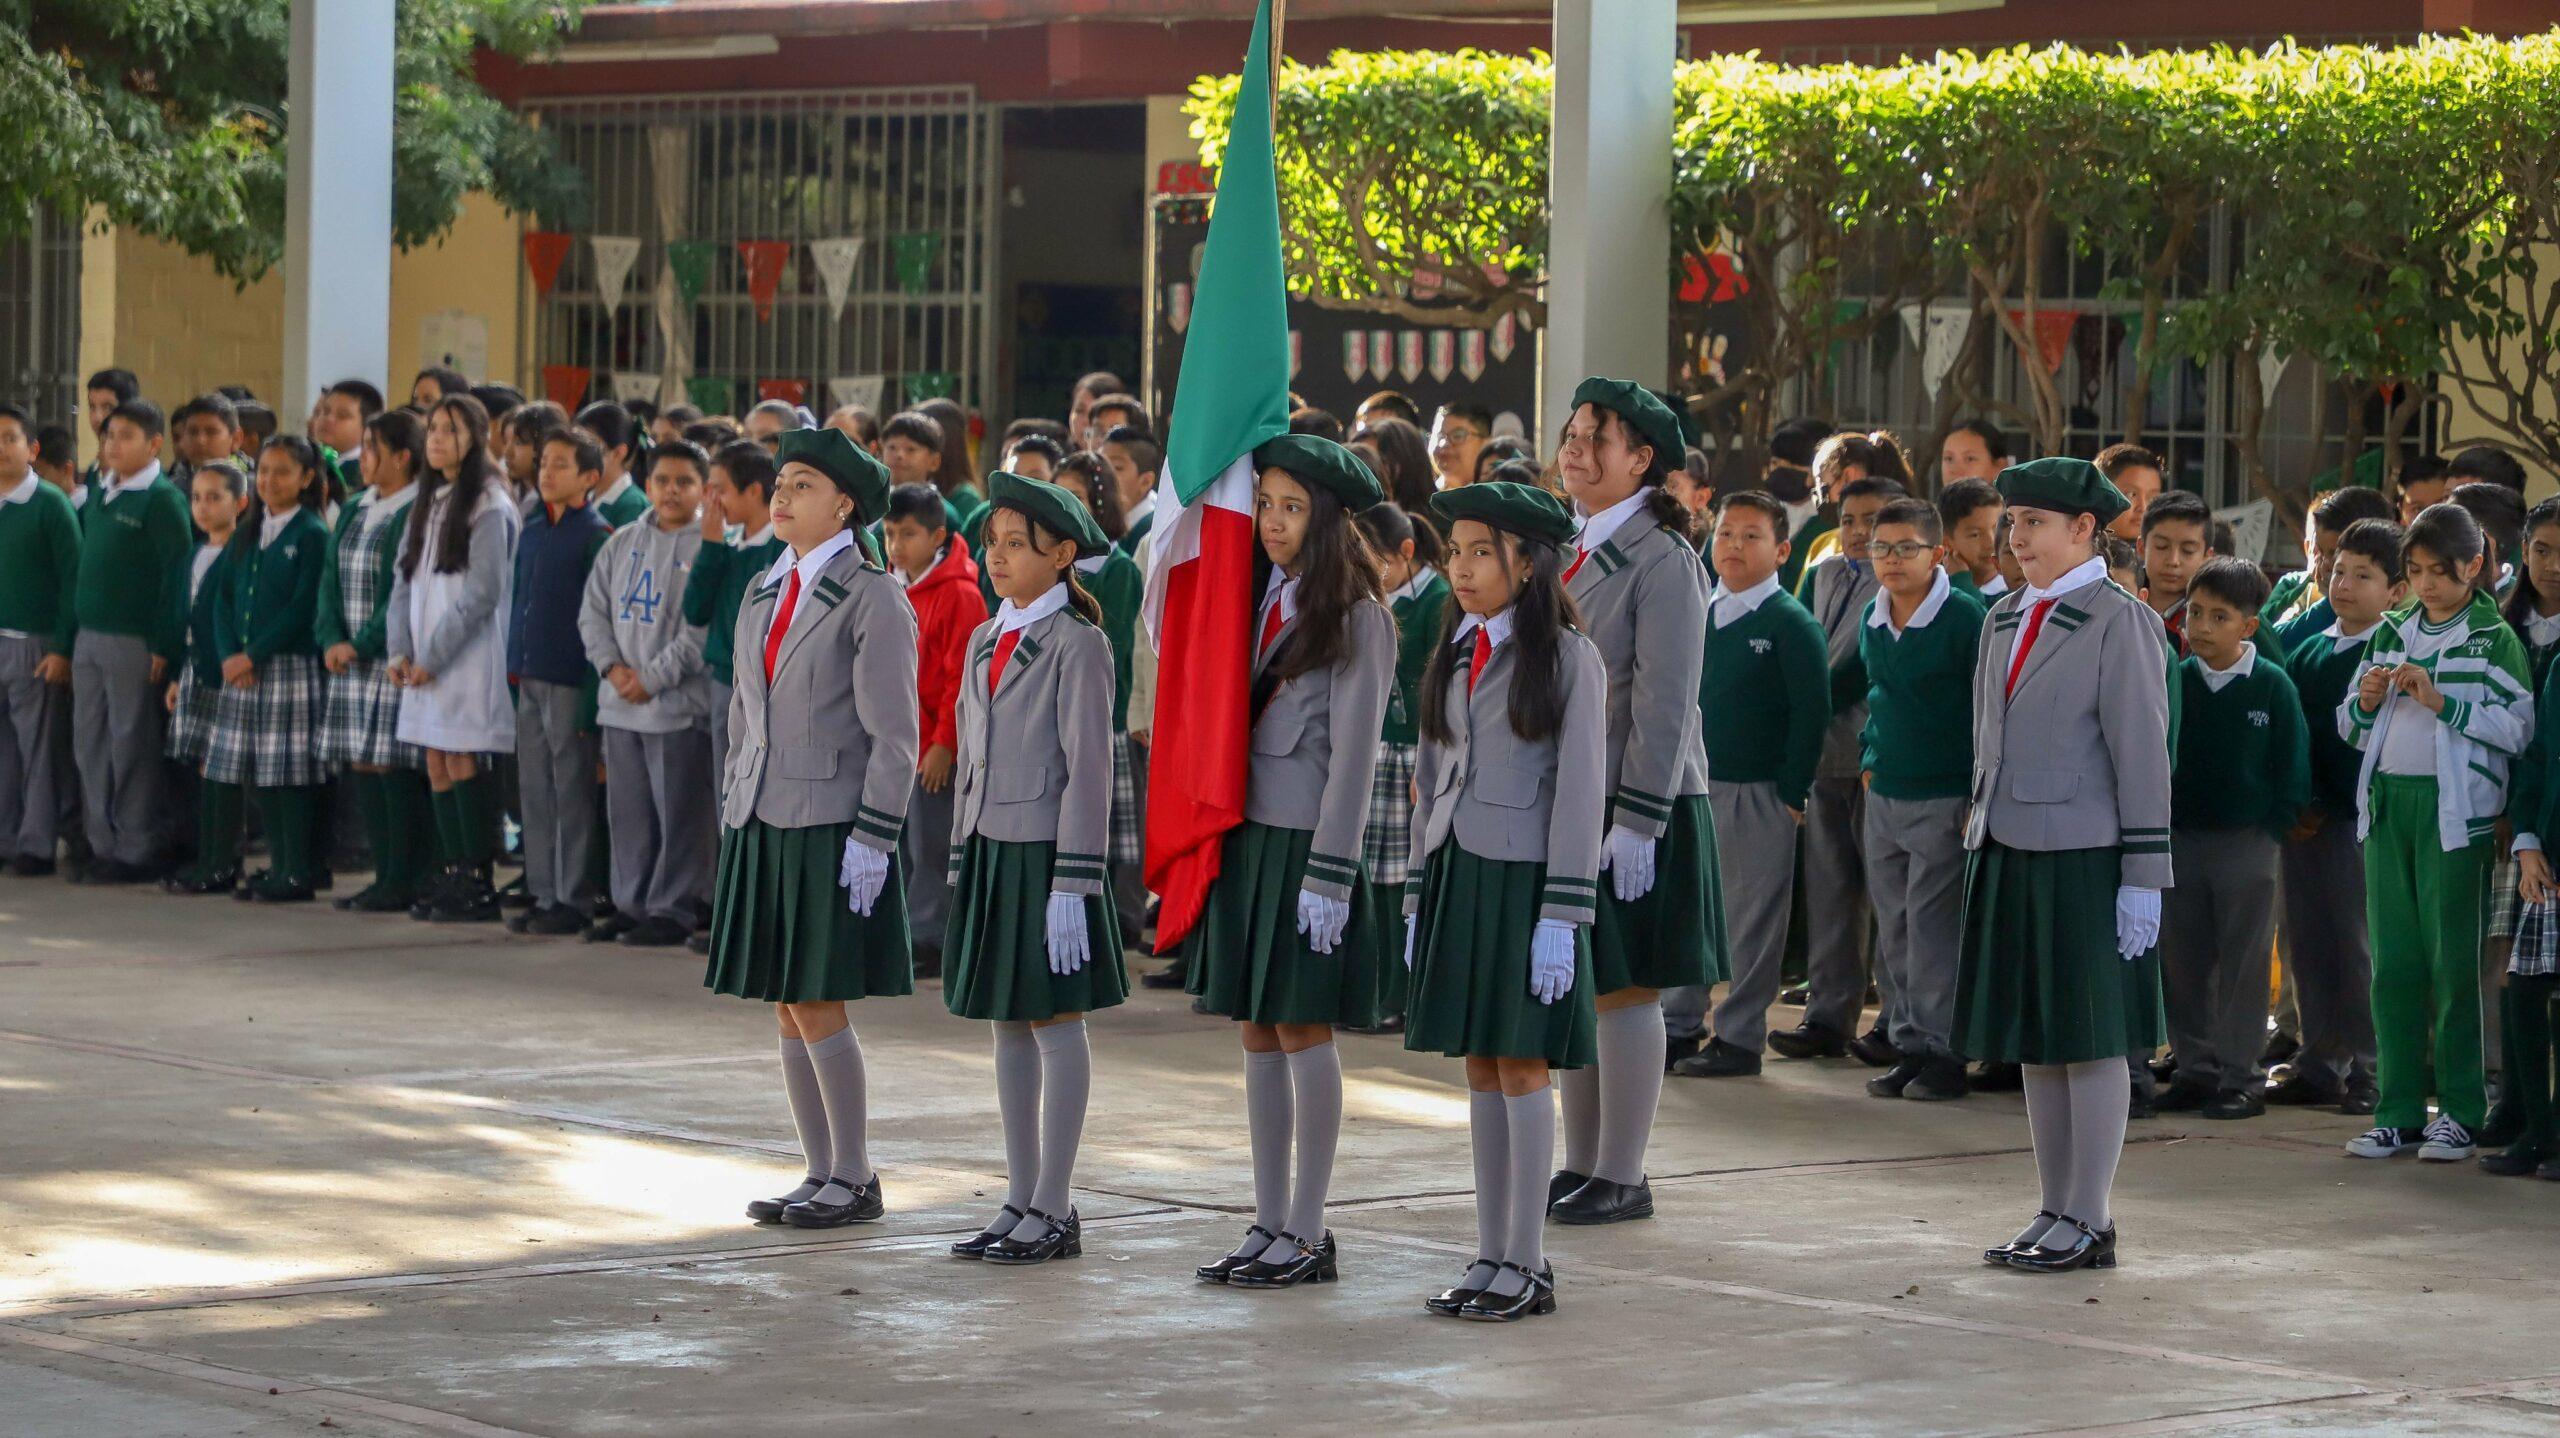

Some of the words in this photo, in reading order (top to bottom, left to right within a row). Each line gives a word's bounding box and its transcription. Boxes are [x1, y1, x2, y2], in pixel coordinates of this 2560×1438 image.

[620, 551, 662, 623] LA
[2463, 637, 2493, 650] ONFIL
[2469, 646, 2484, 655] TX
